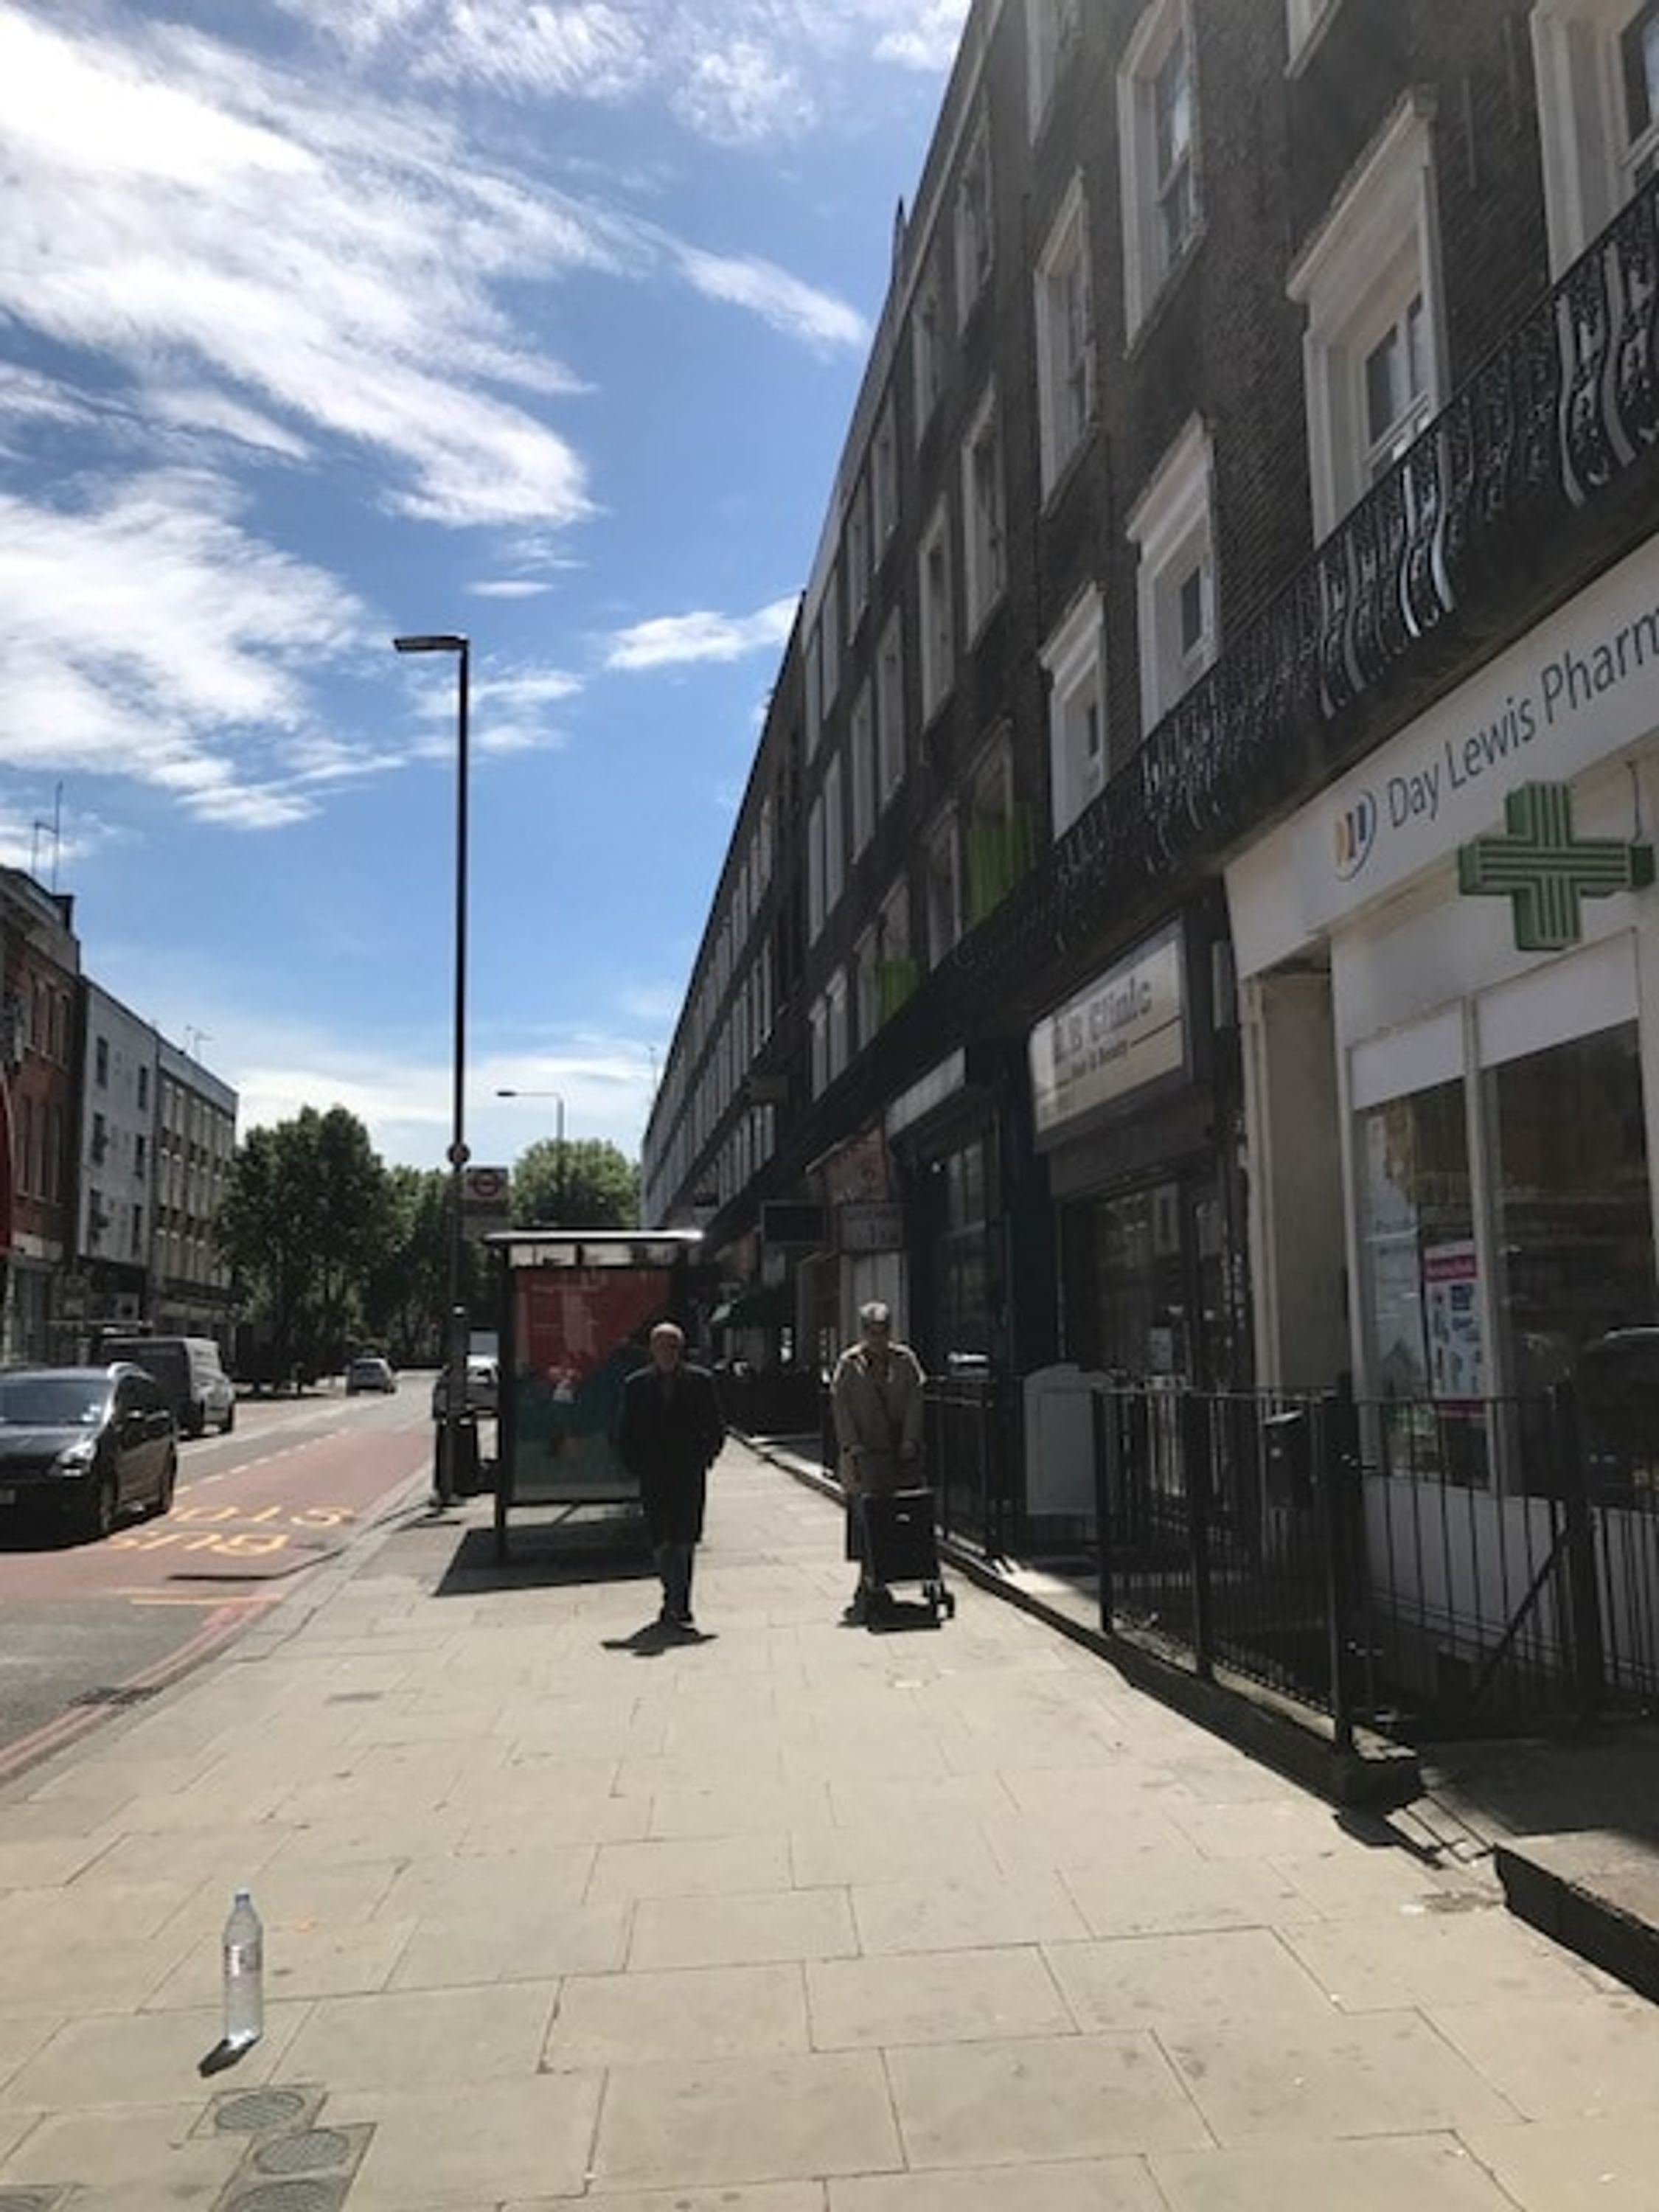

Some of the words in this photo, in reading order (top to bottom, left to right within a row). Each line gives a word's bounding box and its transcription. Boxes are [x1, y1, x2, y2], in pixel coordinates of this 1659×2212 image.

[1388, 764, 1438, 828] Day
[1445, 697, 1537, 790] Lewis
[111, 1531, 290, 1557] BUS
